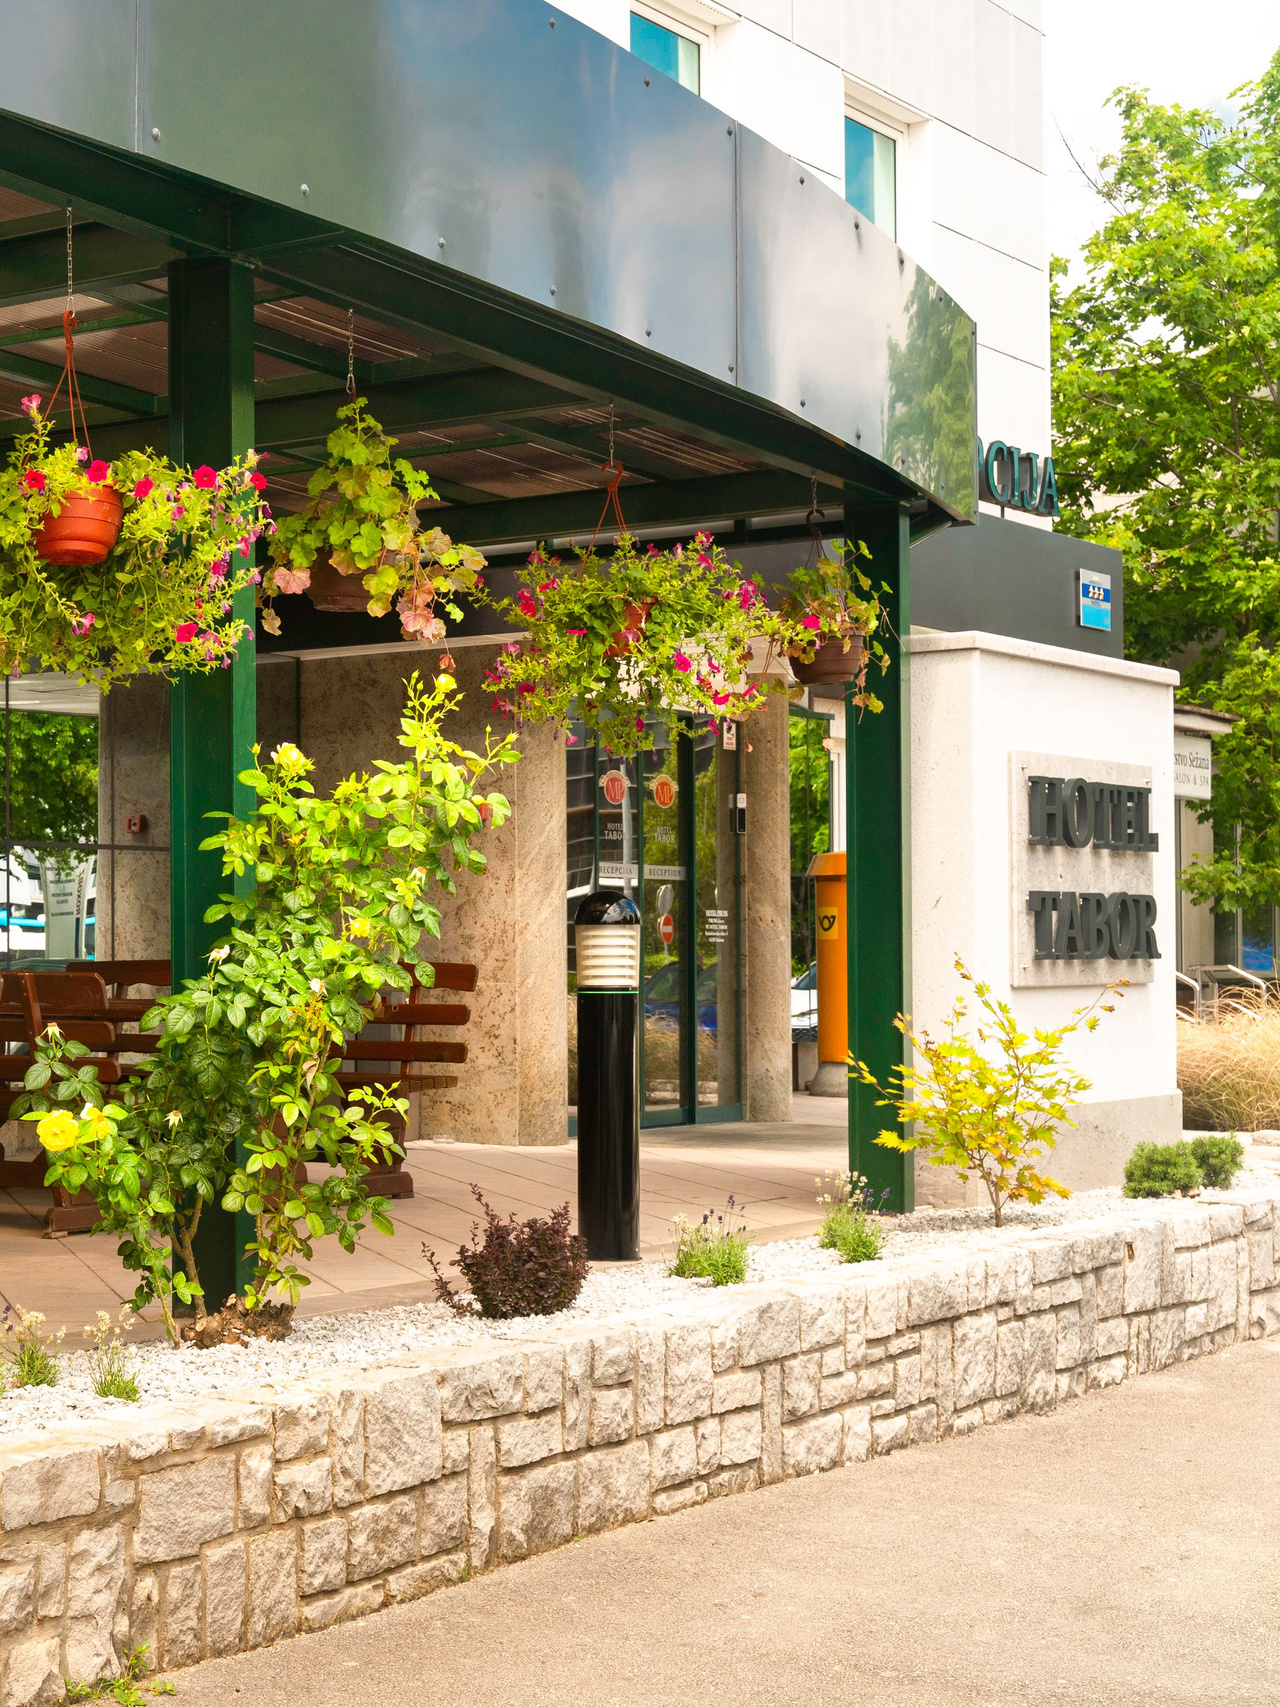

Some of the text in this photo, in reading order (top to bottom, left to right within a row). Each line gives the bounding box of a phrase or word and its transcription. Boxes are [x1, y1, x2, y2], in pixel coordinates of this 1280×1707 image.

[1189, 752, 1209, 770] Sežana
[1028, 776, 1159, 852] HOTEL
[604, 831, 623, 840] TABO
[648, 868, 681, 877] RECEPTION
[1029, 891, 1161, 960] TABOR
